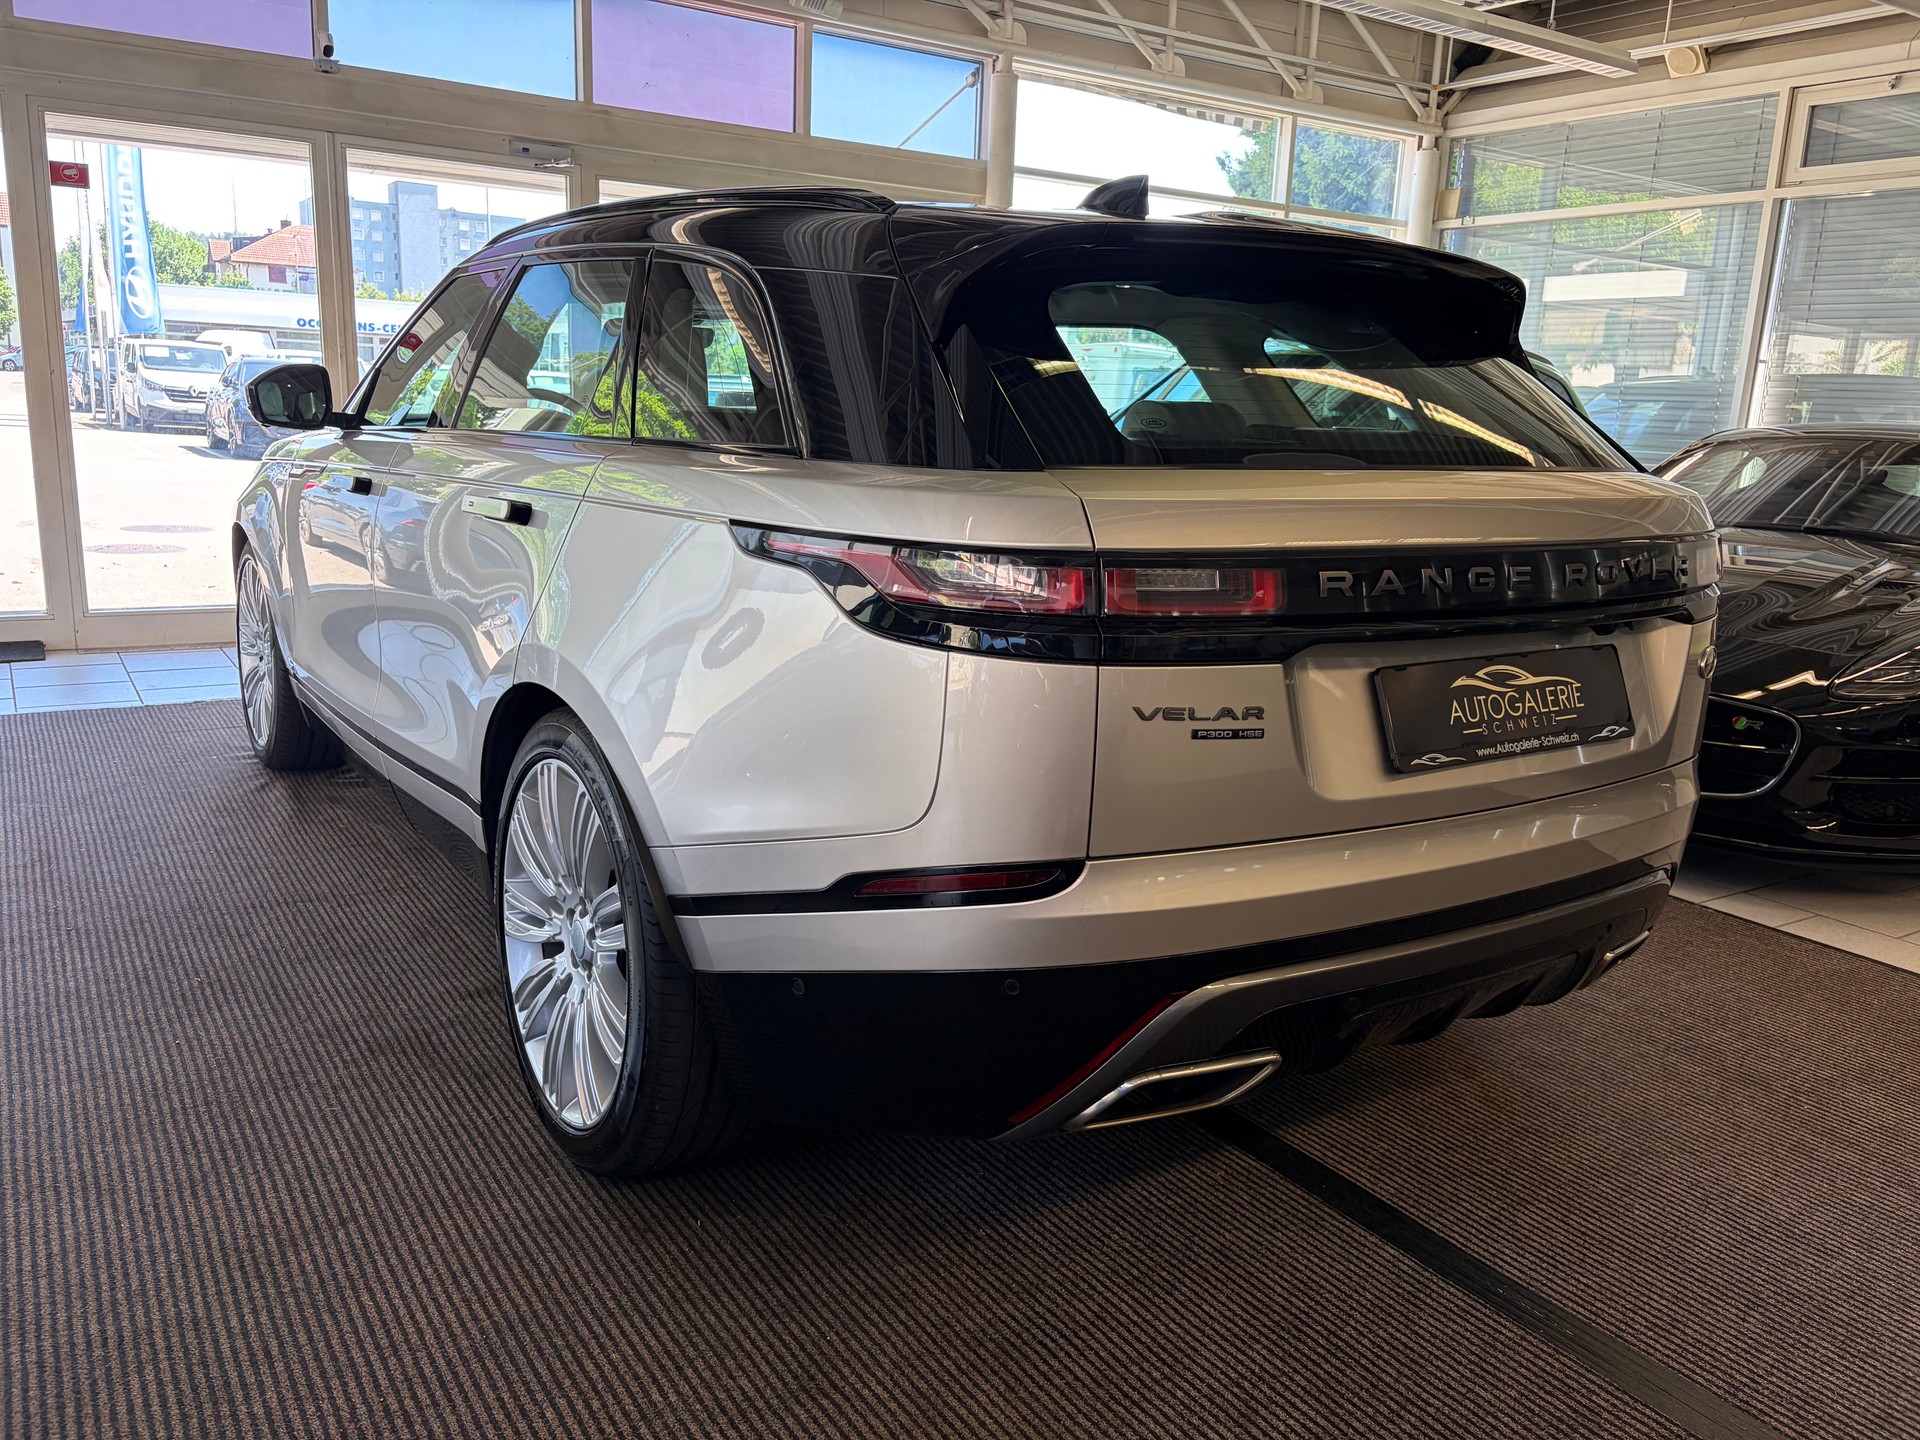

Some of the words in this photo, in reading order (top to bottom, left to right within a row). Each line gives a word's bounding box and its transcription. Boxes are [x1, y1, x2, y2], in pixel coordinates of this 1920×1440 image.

[116, 144, 145, 260] HYUND
[1318, 565, 1533, 598] RANGE
[1564, 555, 1690, 588] ROVER
[1132, 706, 1265, 721] VELAR
[1450, 683, 1585, 725] AUTOGALERIE
[1197, 730, 1233, 738] P300
[1238, 730, 1264, 738] HSE
[1481, 713, 1557, 735] SCHWEIZ
[1475, 732, 1580, 757] www.Autogalerie-Schweiz.ch
